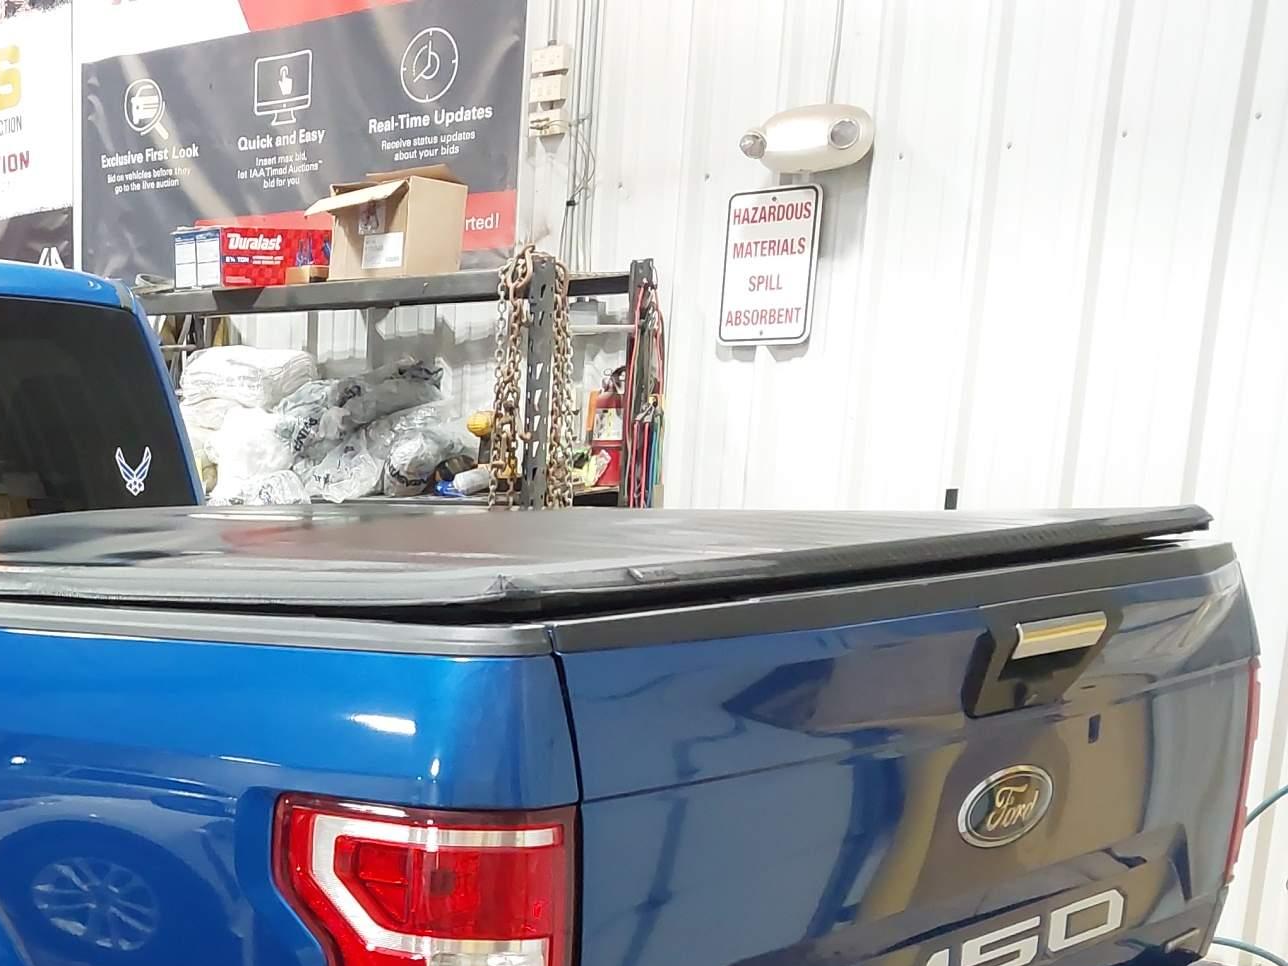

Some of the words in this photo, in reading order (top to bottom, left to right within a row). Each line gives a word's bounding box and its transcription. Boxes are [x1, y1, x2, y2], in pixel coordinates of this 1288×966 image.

[368, 113, 430, 134] Real-Time
[434, 106, 493, 127] Updates
[237, 134, 273, 151] Quick
[275, 130, 296, 147] and
[298, 128, 325, 144] Easy
[381, 138, 412, 151] Receive
[413, 135, 438, 147] status
[440, 130, 476, 144] updates
[101, 151, 144, 168] Exclusive
[145, 147, 168, 162] First
[172, 143, 199, 159] Look
[256, 156, 276, 166] Insert
[278, 154, 293, 164] max
[394, 149, 417, 161] about
[419, 148, 439, 160] your
[441, 144, 460, 156] bids
[125, 170, 152, 180] vehicles
[153, 168, 173, 178] before
[249, 168, 265, 178] IAA
[114, 185, 123, 195] go
[130, 182, 141, 191] the
[142, 181, 155, 190] live
[156, 178, 180, 189] auction
[263, 179, 275, 189] bid
[276, 177, 286, 186] for
[287, 177, 300, 187] you
[465, 212, 500, 231] rted!
[733, 202, 812, 225] HAZARDOUS
[227, 232, 282, 250] Duralast
[733, 237, 806, 259] MATERIALS
[748, 274, 783, 292] SPILL
[726, 307, 802, 327] ABSORBENT
[985, 784, 1040, 832] Ford
